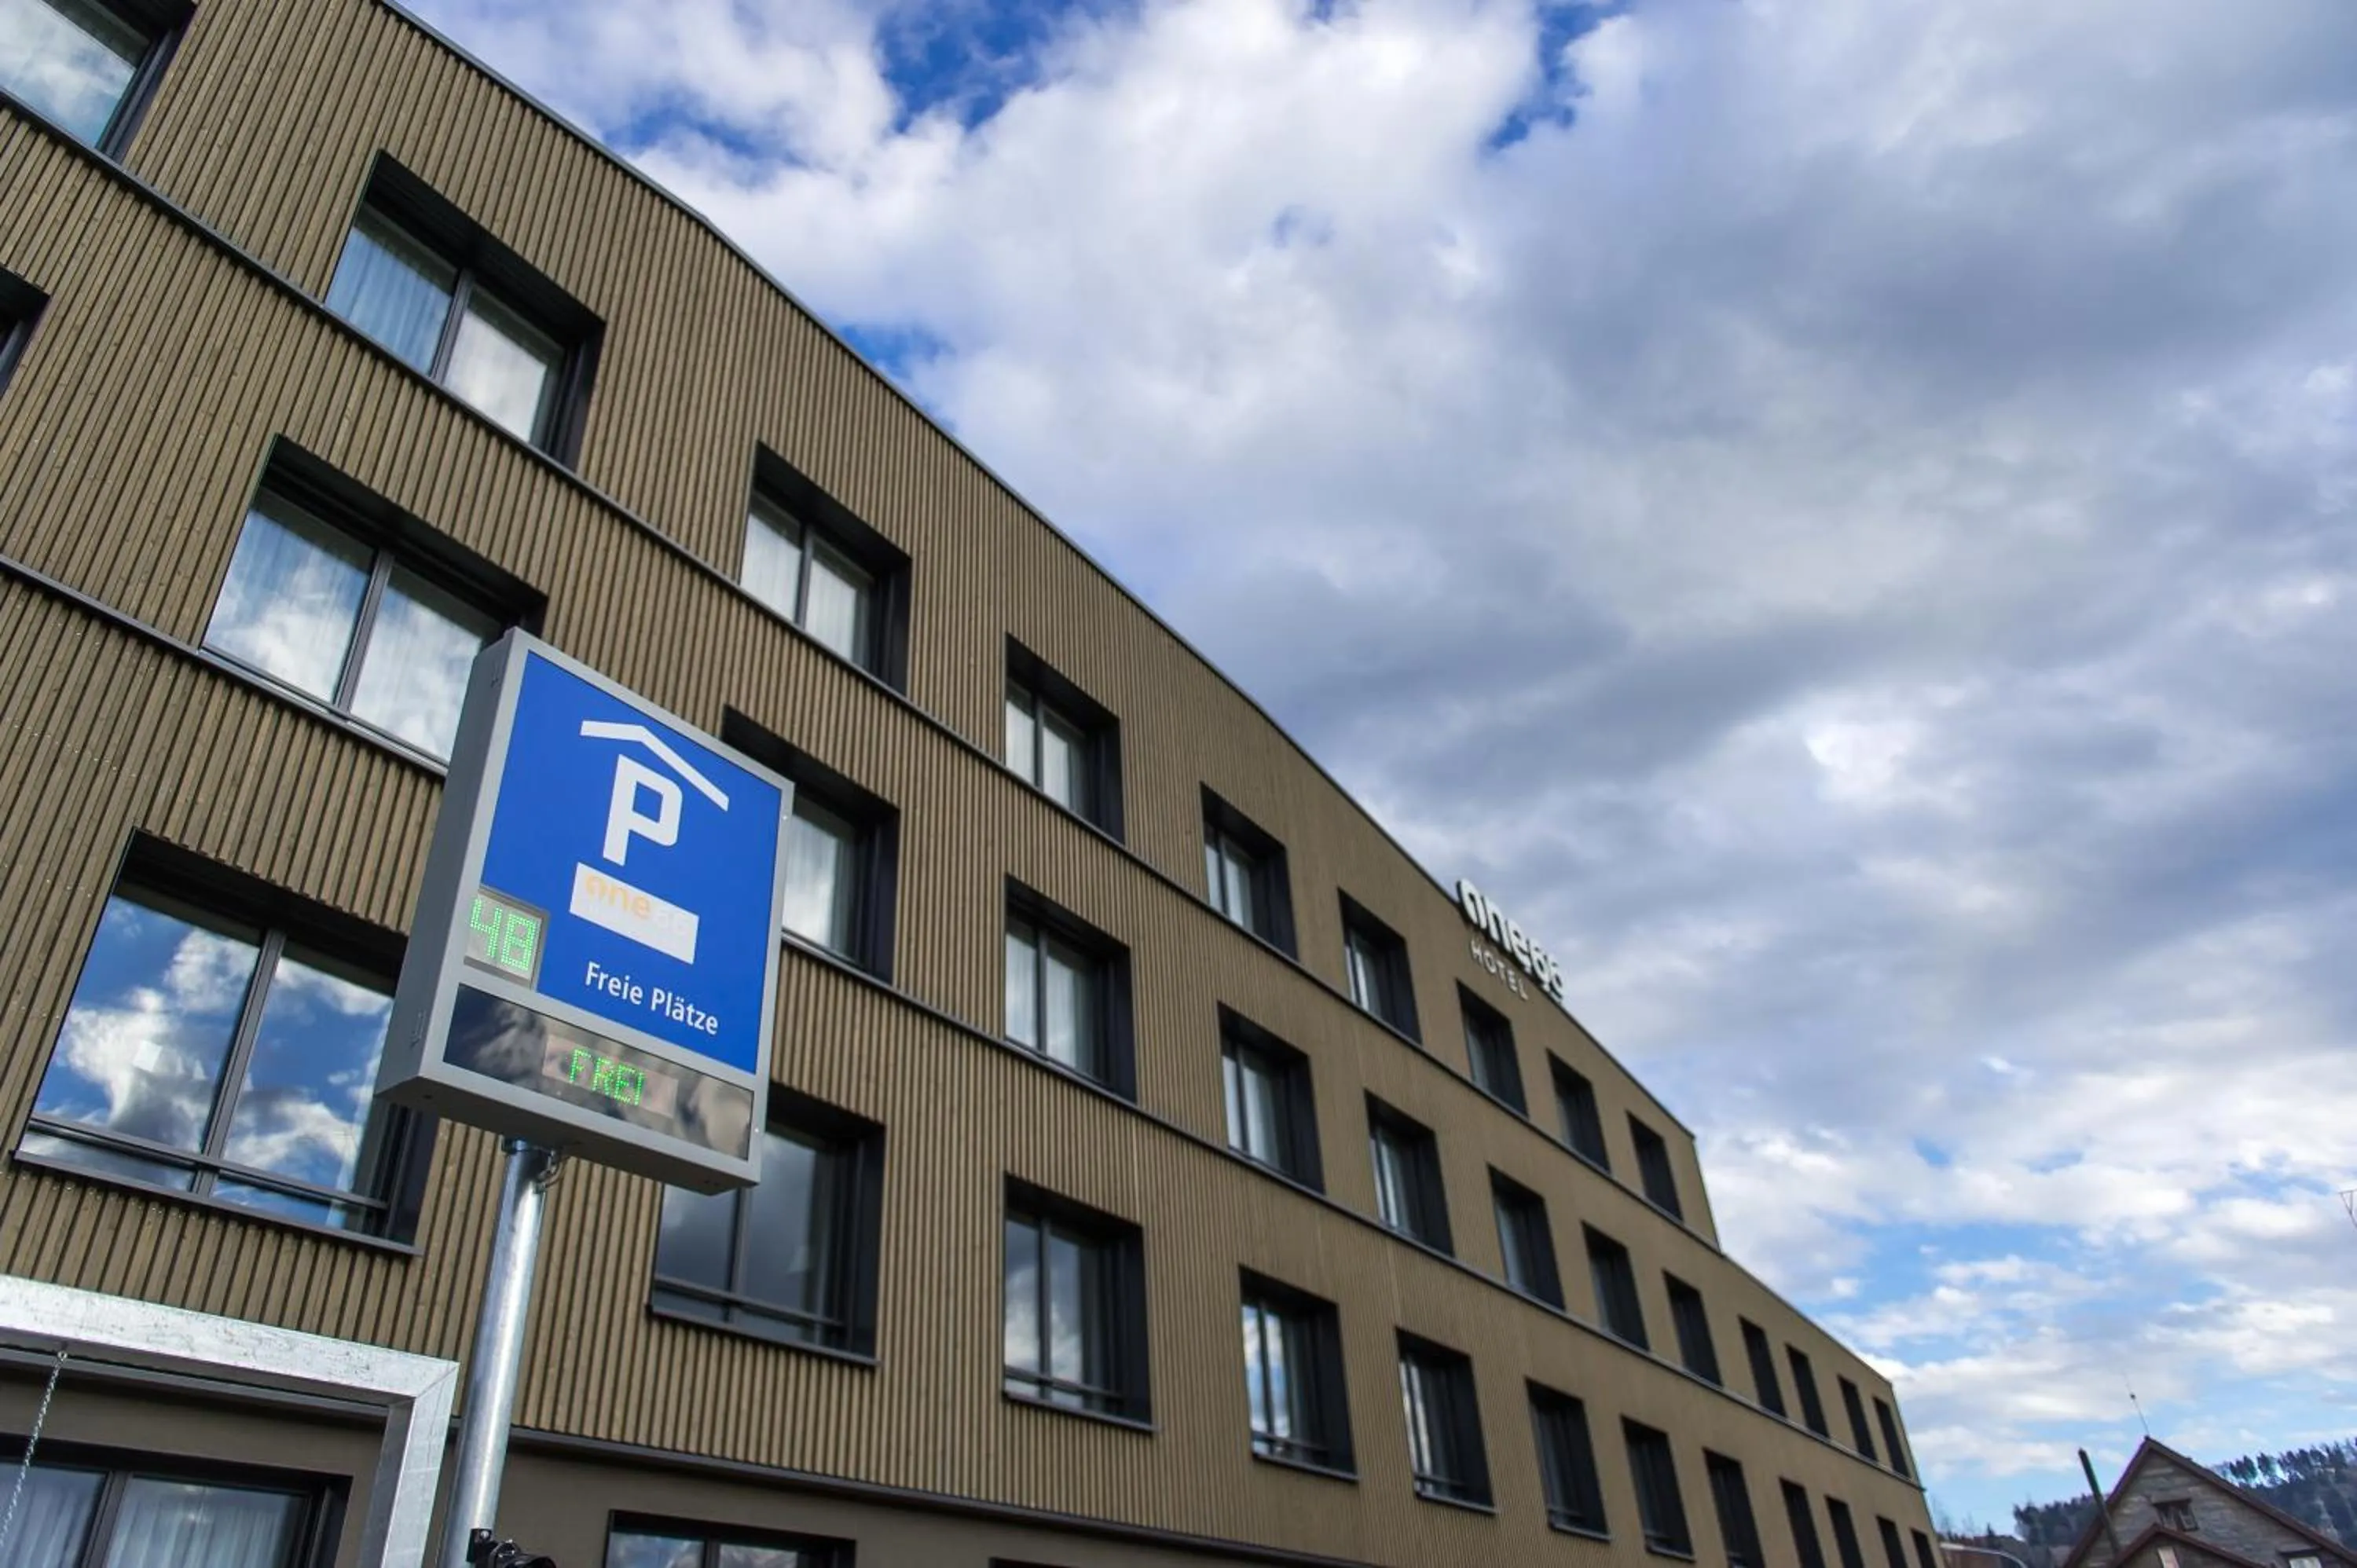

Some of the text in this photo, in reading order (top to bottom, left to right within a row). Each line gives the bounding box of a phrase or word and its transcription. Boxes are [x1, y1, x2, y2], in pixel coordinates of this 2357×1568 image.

[603, 753, 683, 867] P
[470, 898, 536, 971] 48
[1471, 939, 1528, 1001] HOTEL
[585, 961, 719, 1035] Freie Plätze
[569, 1049, 644, 1106] FREI
